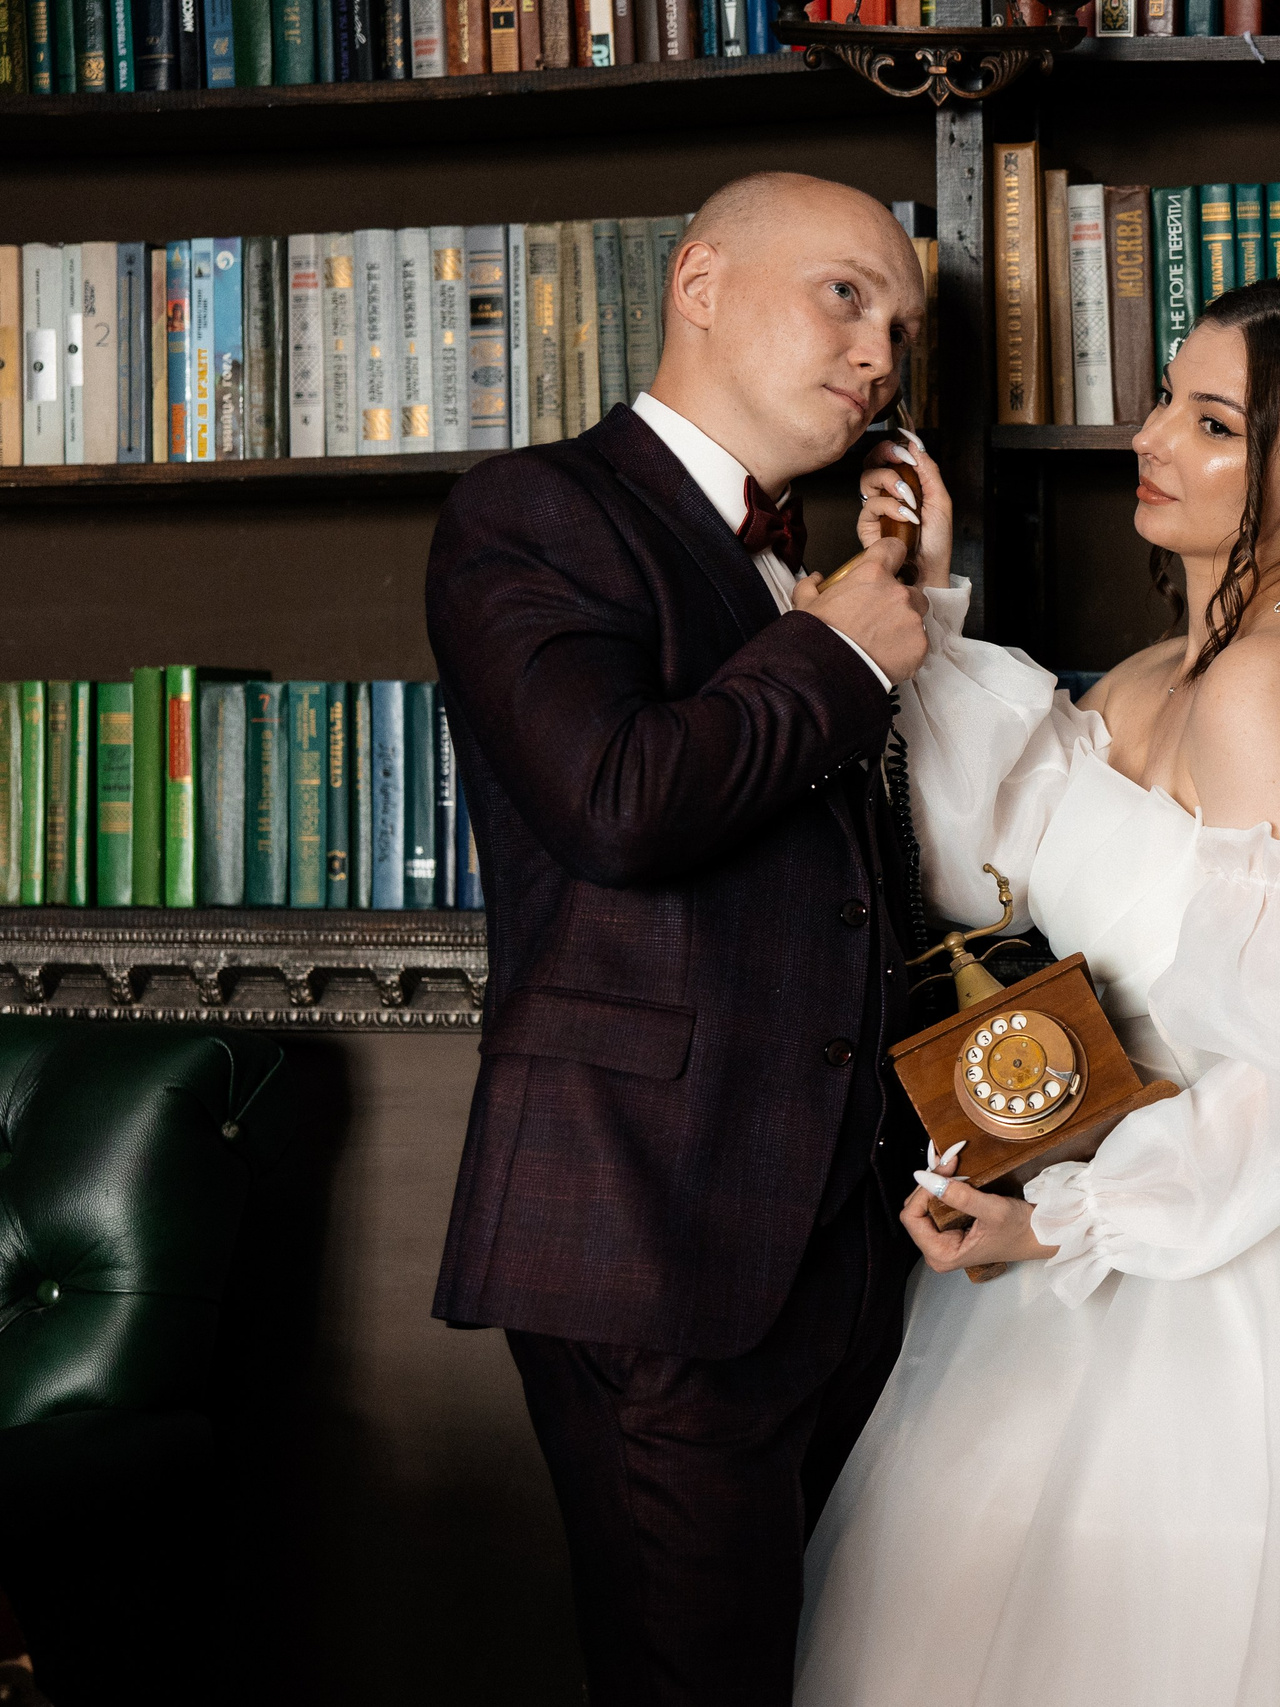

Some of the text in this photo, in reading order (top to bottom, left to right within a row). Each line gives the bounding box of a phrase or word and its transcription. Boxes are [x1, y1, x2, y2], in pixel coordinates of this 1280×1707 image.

[1115, 209, 1144, 298] МОСКВА
[1165, 194, 1183, 260] ПЕРЕЙТИ
[1002, 175, 1024, 383] ПЛУТОВСКОЙ РОМАН
[1168, 264, 1184, 308] ПОЛЕ
[95, 322, 111, 347] 2
[1169, 310, 1186, 330] НЕ
[330, 701, 344, 788] СТЕНДАЛЬ
